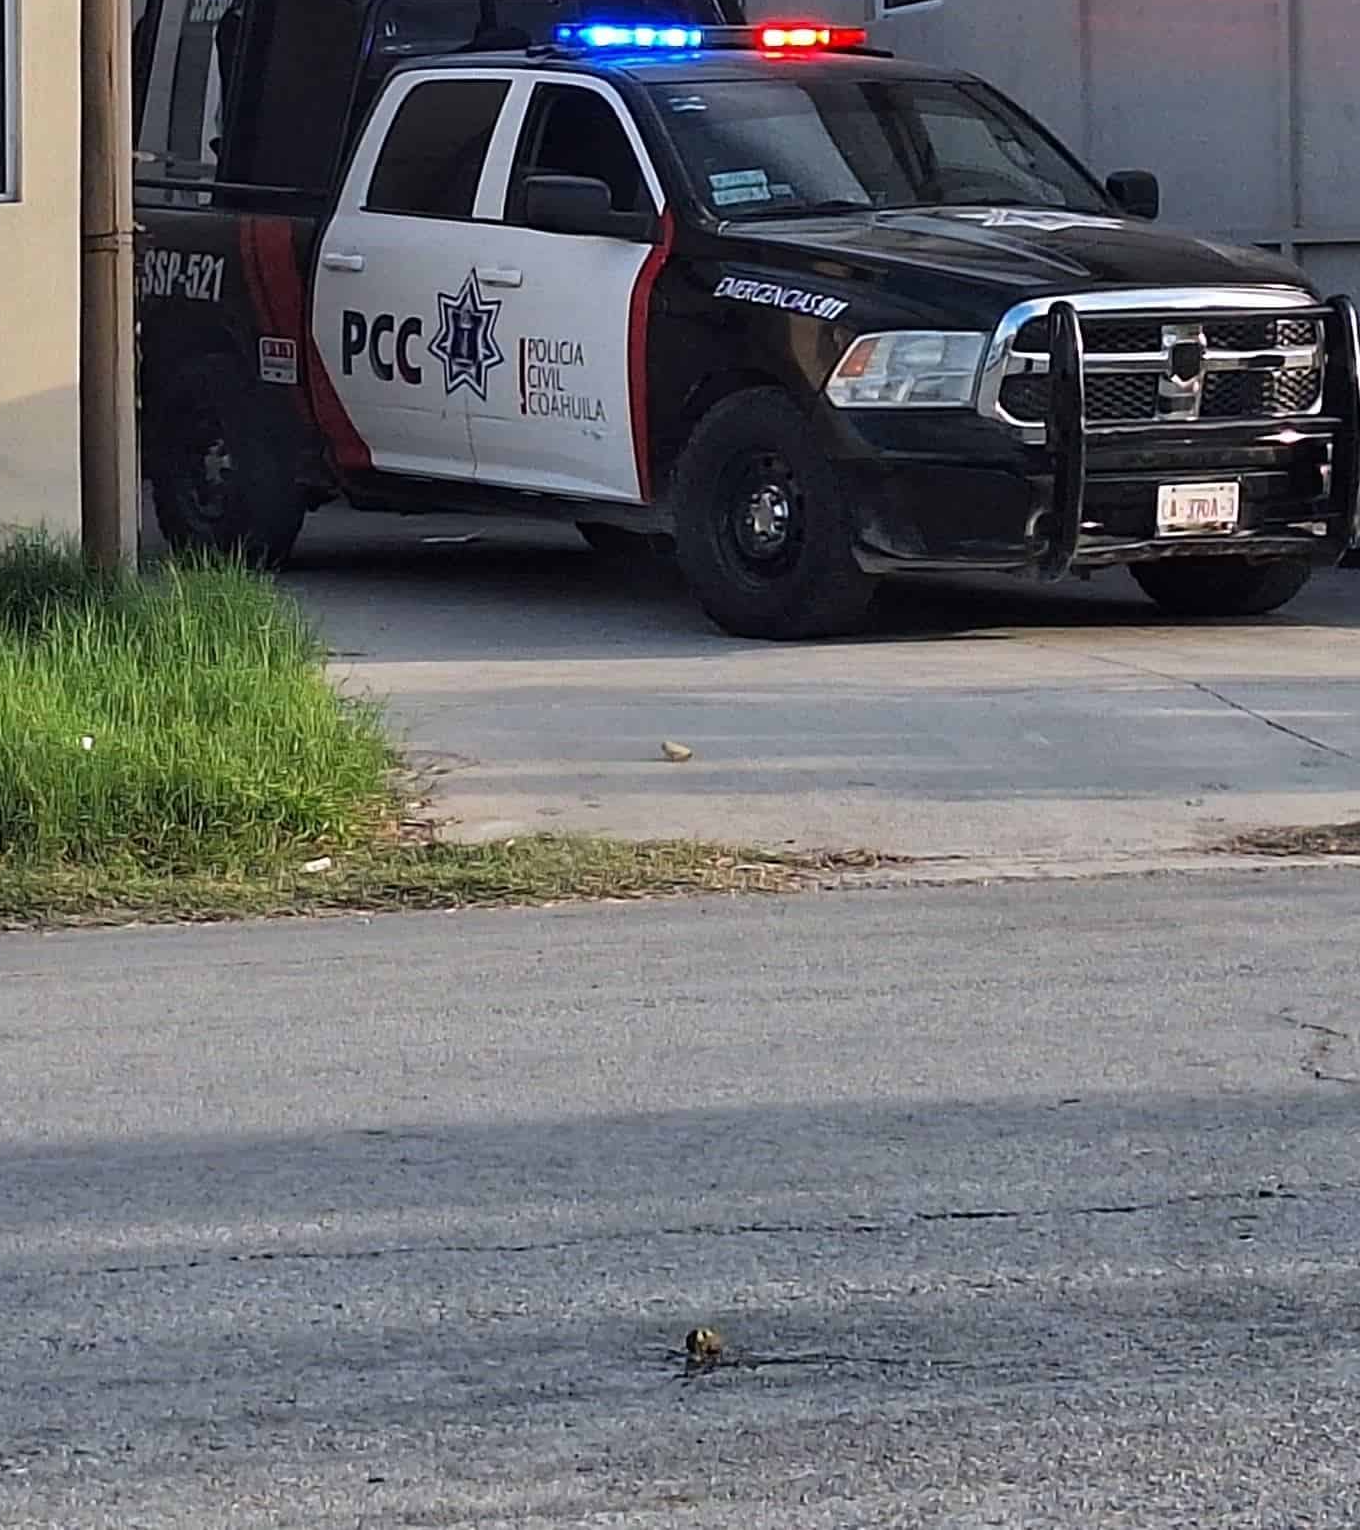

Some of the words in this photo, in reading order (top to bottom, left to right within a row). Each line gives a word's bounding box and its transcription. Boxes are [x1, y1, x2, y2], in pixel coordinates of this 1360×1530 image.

[142, 250, 225, 302] SSP-521
[342, 309, 423, 385] PCC
[527, 338, 585, 366] POLICIA
[527, 364, 566, 391] CIVIL
[528, 391, 607, 422] COAHUILA
